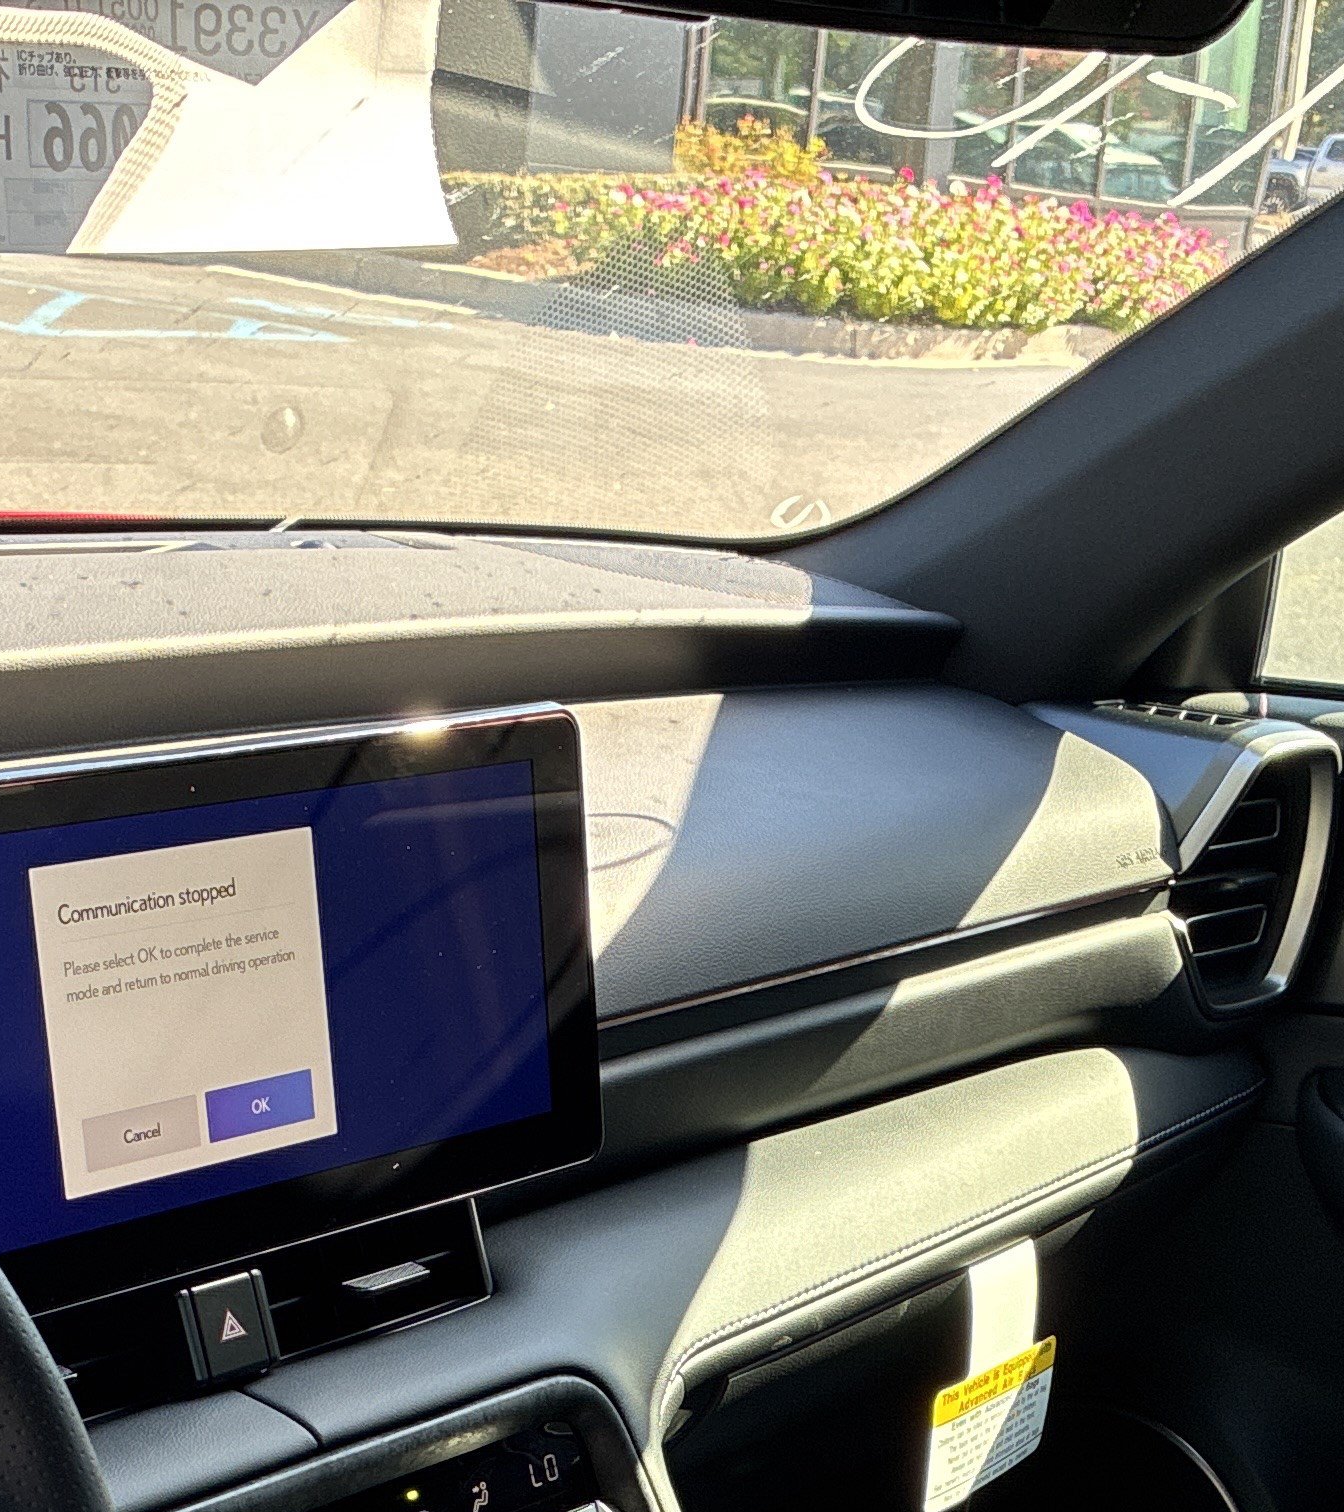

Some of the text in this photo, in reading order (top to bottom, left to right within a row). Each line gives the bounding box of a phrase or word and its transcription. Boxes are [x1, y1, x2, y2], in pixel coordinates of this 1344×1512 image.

[57, 878, 237, 925] Communication stopped
[63, 927, 280, 977] Please select OK to complete the service
[66, 949, 296, 1002] mode and return to normal driving operation
[251, 1096, 271, 1115] OK
[123, 1122, 162, 1145] Cancel
[941, 1385, 960, 1406] This
[963, 1373, 992, 1397] Vehicle
[993, 1367, 1000, 1381] is
[958, 1387, 998, 1413] Advanced
[528, 1454, 560, 1489] LO
